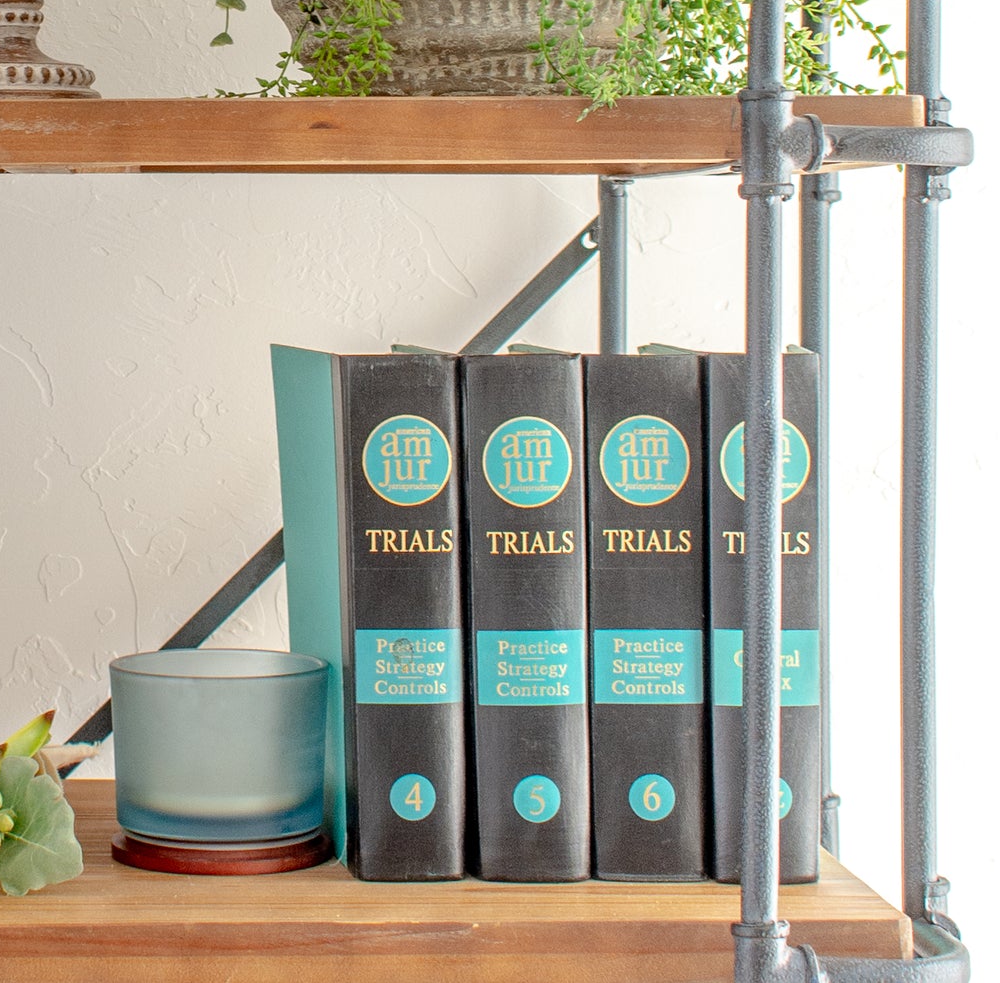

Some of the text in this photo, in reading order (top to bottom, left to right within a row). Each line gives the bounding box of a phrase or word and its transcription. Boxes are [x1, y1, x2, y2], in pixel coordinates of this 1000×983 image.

[381, 432, 432, 456] am
[501, 434, 553, 458] am
[619, 432, 670, 456] am
[379, 458, 431, 487] jur
[499, 460, 552, 489] jur
[616, 458, 669, 487] jur
[365, 530, 453, 552] TRIALS
[486, 531, 574, 554] TRIALS
[603, 529, 692, 552] TRIALS
[376, 638, 445, 653] Practice
[498, 640, 568, 655] Practice
[613, 638, 684, 653] Practice
[376, 660, 445, 674] Strategy
[498, 661, 568, 678] Strategy
[612, 660, 684, 676] Strategy
[374, 680, 447, 694] Controls
[496, 682, 570, 697] Controls
[611, 680, 685, 695] Controls
[404, 782, 423, 811] 4
[530, 785, 546, 815] 5
[643, 781, 661, 811] 6
